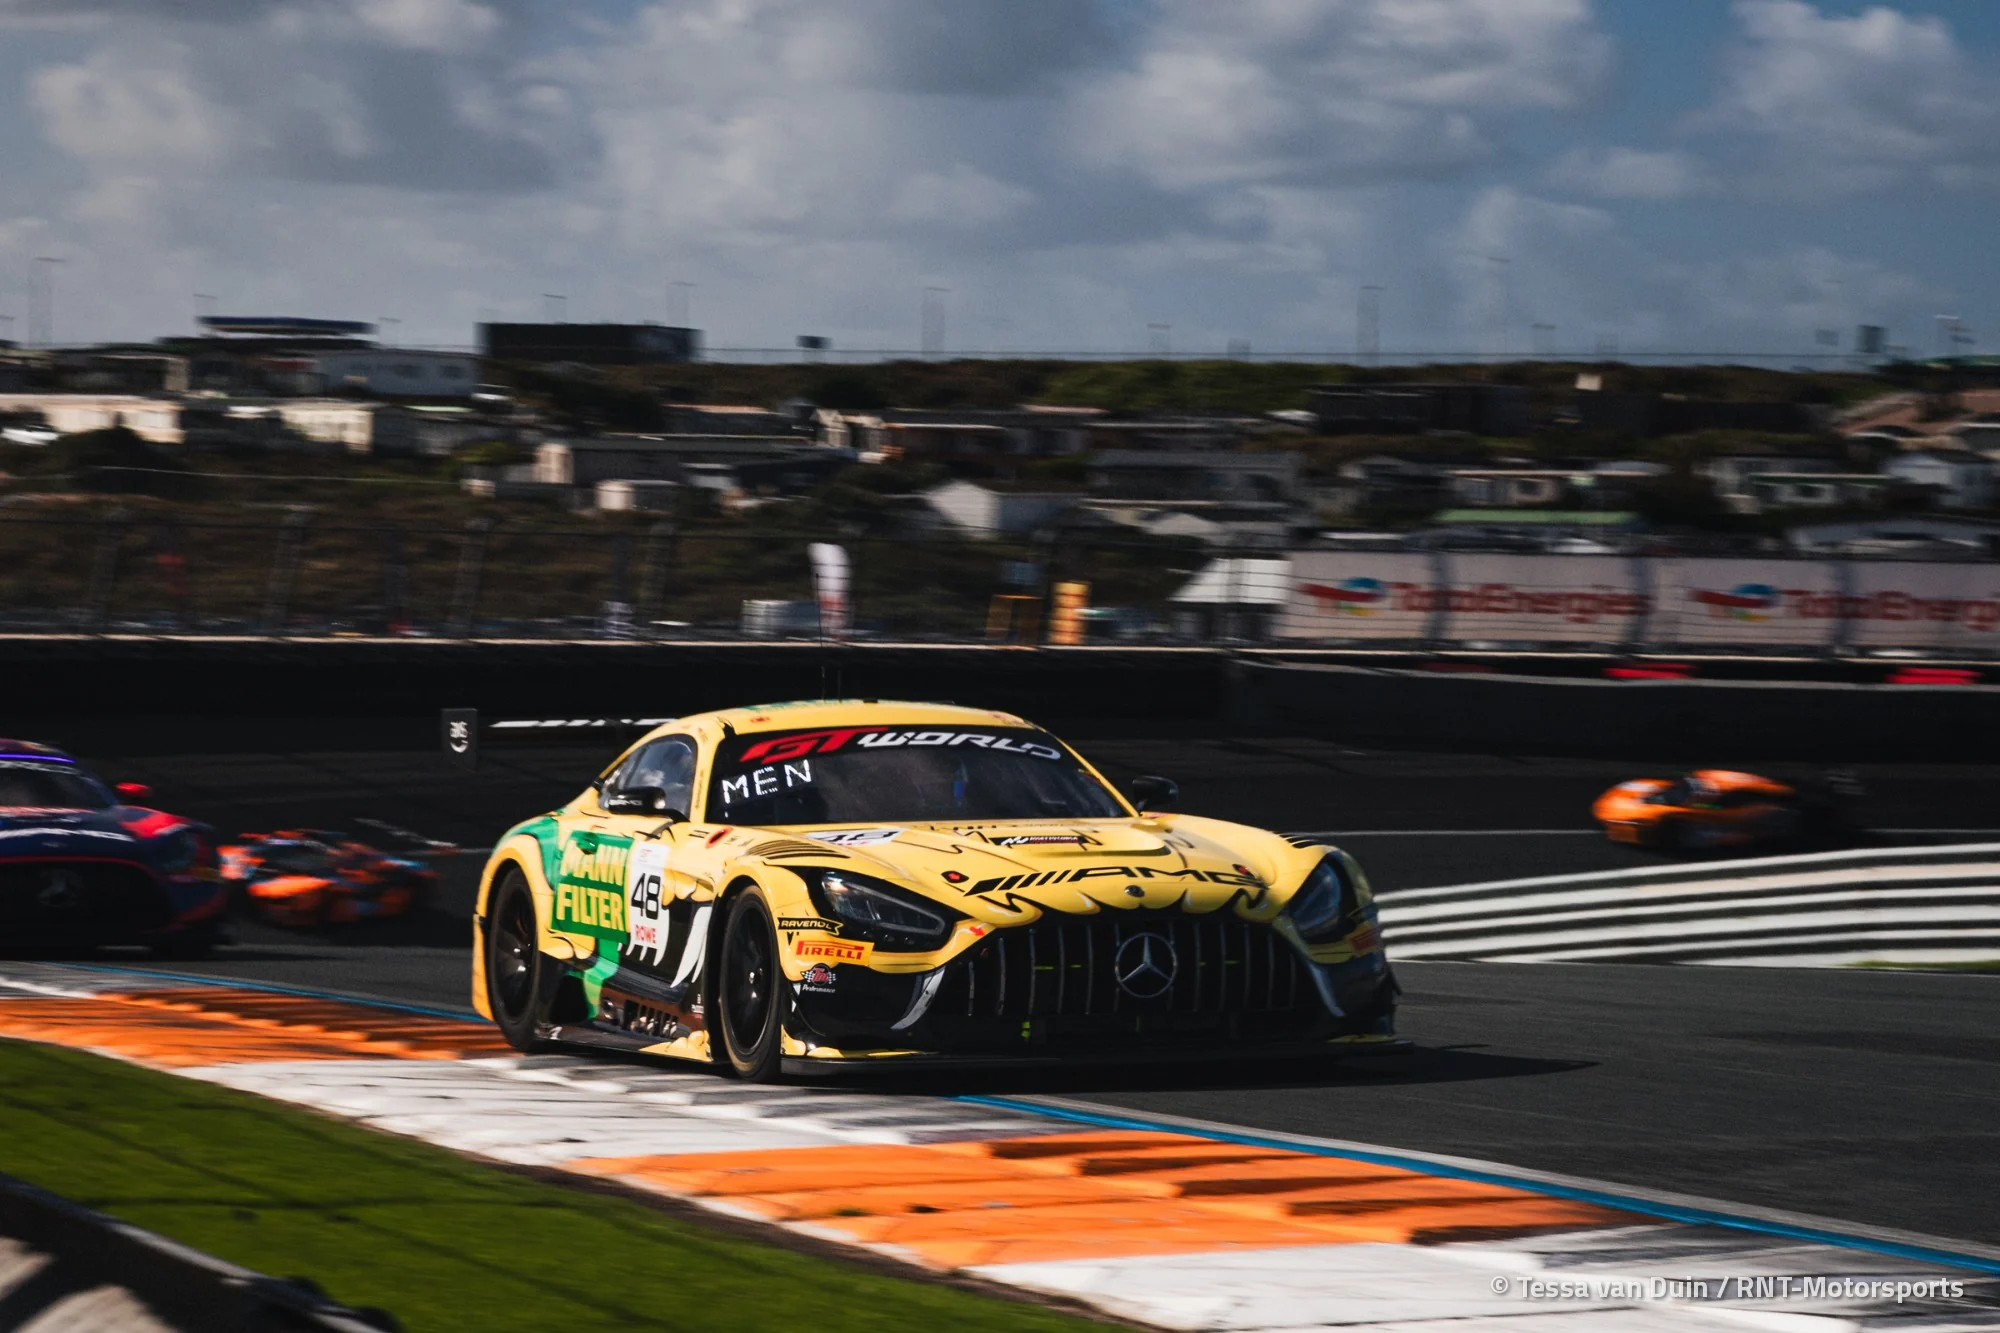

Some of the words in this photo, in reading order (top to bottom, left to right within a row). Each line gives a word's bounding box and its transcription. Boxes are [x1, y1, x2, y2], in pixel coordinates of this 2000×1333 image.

[740, 727, 889, 764] GT
[857, 731, 1062, 761] WORLD
[722, 759, 812, 804] MEN
[560, 838, 629, 887] MANN
[1067, 866, 1269, 891] AMG
[556, 882, 625, 932] FILTER
[631, 872, 661, 921] 48
[635, 924, 657, 945] ROWE
[781, 920, 833, 930] RAVENOL
[796, 940, 865, 960] PIRELLI
